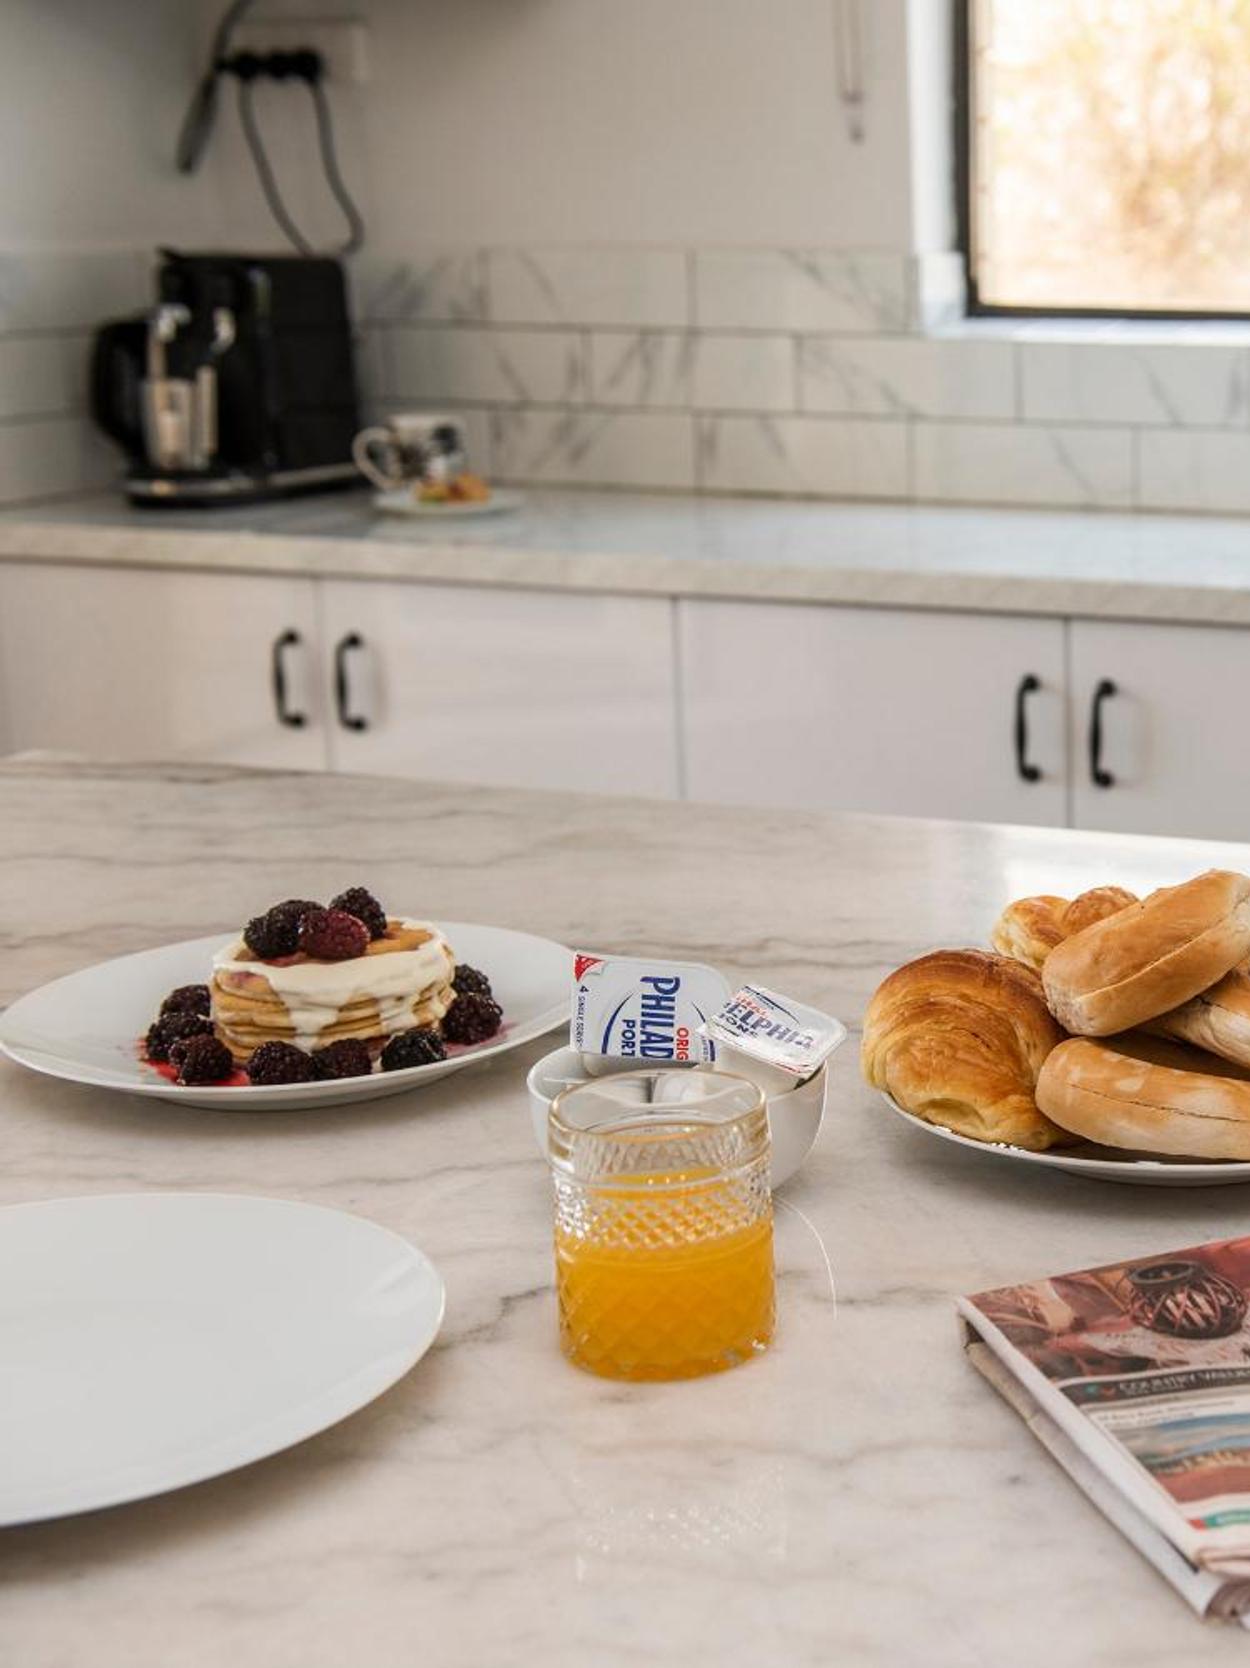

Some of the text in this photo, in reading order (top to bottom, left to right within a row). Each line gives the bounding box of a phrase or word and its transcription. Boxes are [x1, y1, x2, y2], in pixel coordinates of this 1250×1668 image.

[580, 985, 589, 993] 4
[640, 976, 680, 1058] PHILAD
[621, 1019, 636, 1056] PORT
[676, 1027, 689, 1060] ORIG
